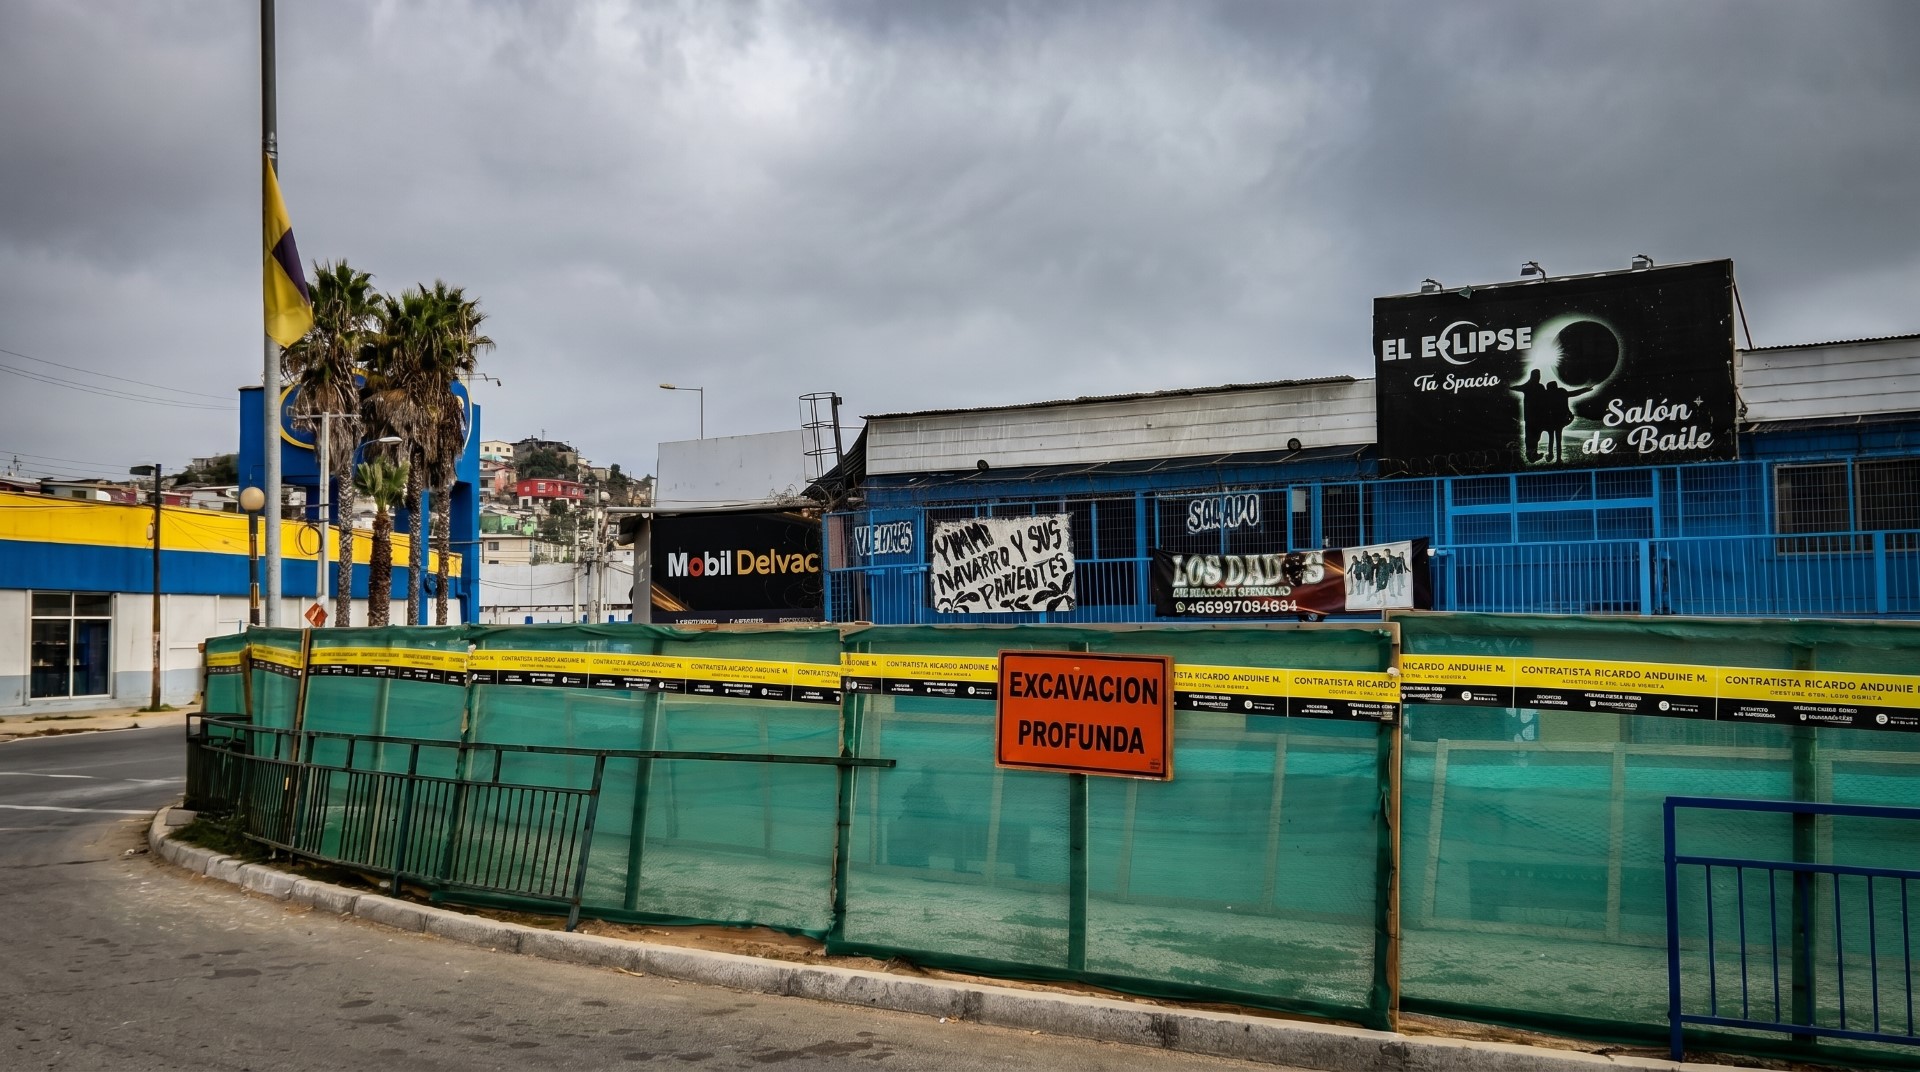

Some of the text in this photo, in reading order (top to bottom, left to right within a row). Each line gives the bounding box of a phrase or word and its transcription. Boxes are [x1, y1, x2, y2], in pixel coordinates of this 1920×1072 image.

[1382, 321, 1532, 365] EL ECLIPSE
[1442, 372, 1500, 394] Spacio
[1603, 398, 1693, 427] Salón
[1582, 425, 1715, 455] de Baile
[668, 550, 731, 577] Mobil
[737, 549, 819, 575] Delvac
[936, 520, 1062, 596] NAVARRO Y SUS
[1172, 554, 1222, 587] LOS
[1294, 677, 1397, 689] CONTRATISTA RICARDO
[1521, 666, 1591, 676] CONTRATISTA
[1595, 669, 1641, 678] RICARDO
[1725, 676, 1801, 687] CONTRATISTA
[1805, 680, 1856, 690] RICARDO
[1009, 671, 1158, 705] EXCAVACION
[1018, 719, 1145, 754] PROFUNDA
